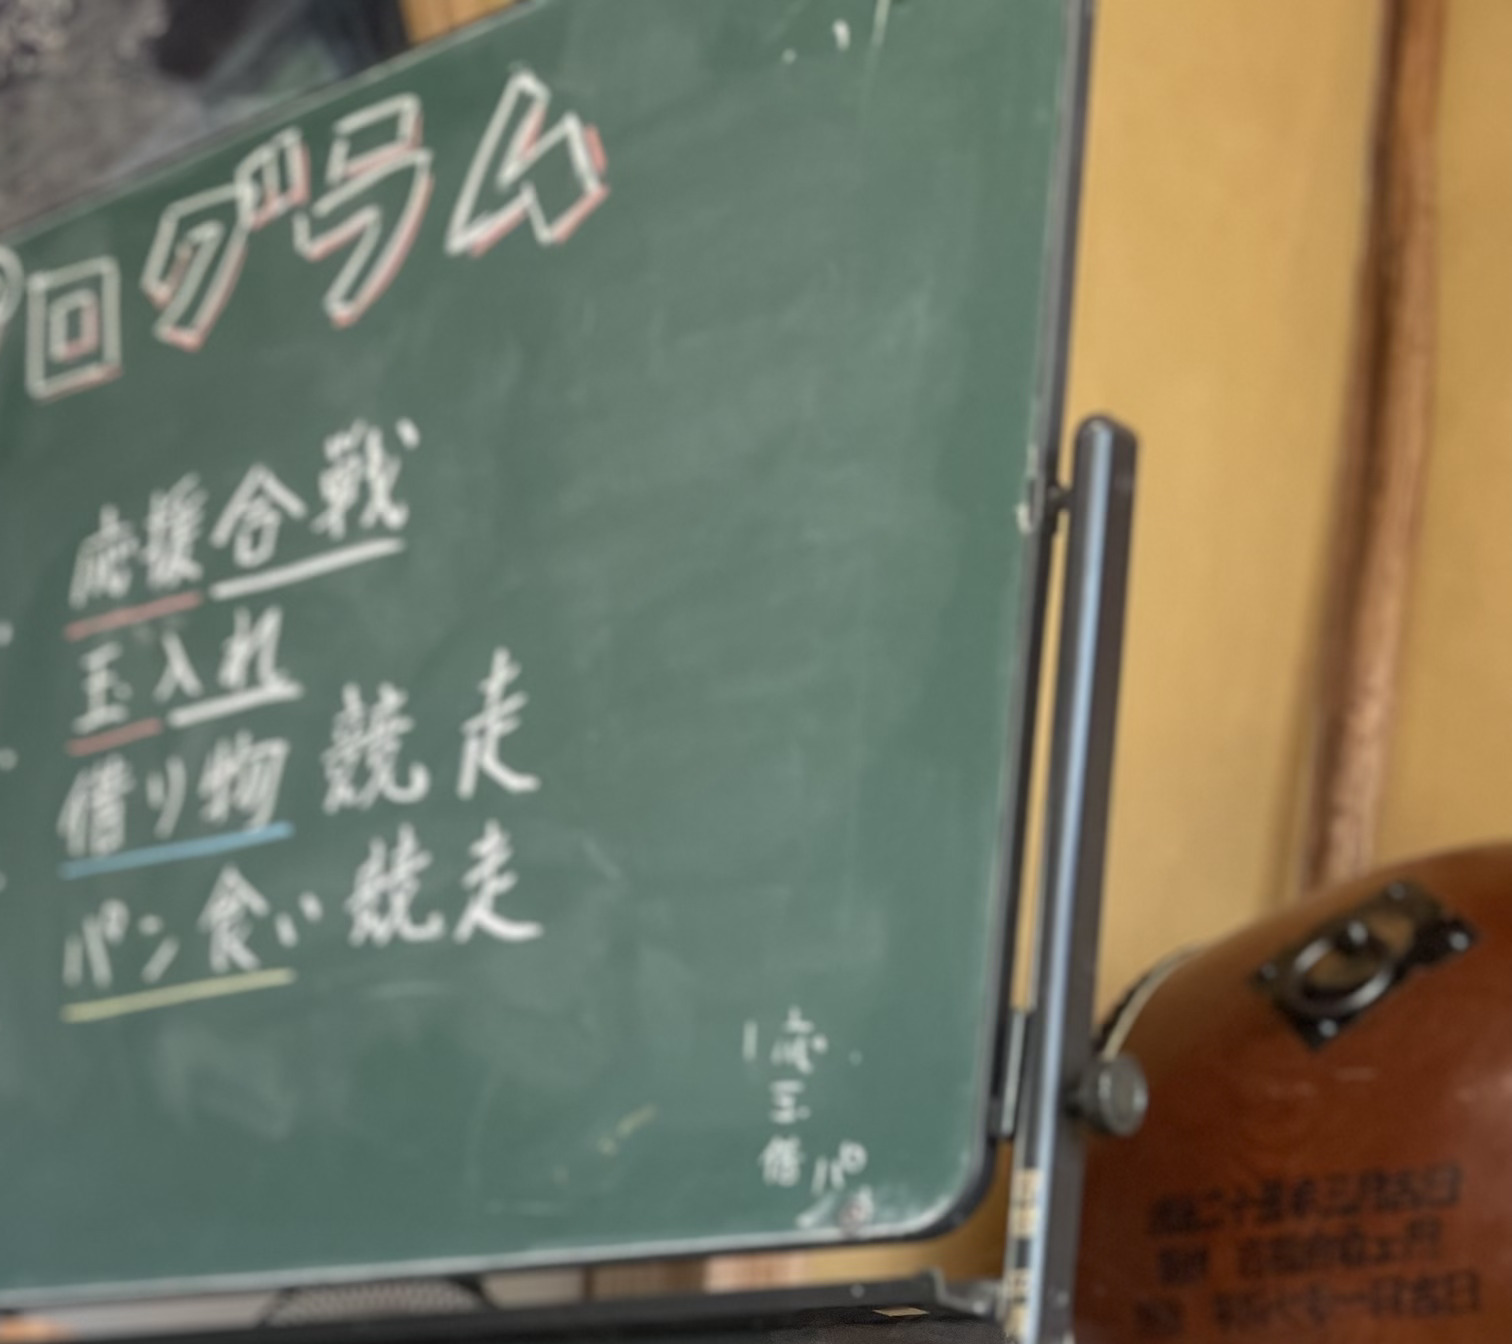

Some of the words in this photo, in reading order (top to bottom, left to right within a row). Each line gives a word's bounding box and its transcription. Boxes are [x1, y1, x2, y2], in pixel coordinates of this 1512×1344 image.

[68, 417, 421, 608] 応援合戦
[70, 602, 296, 737] 玉入れ
